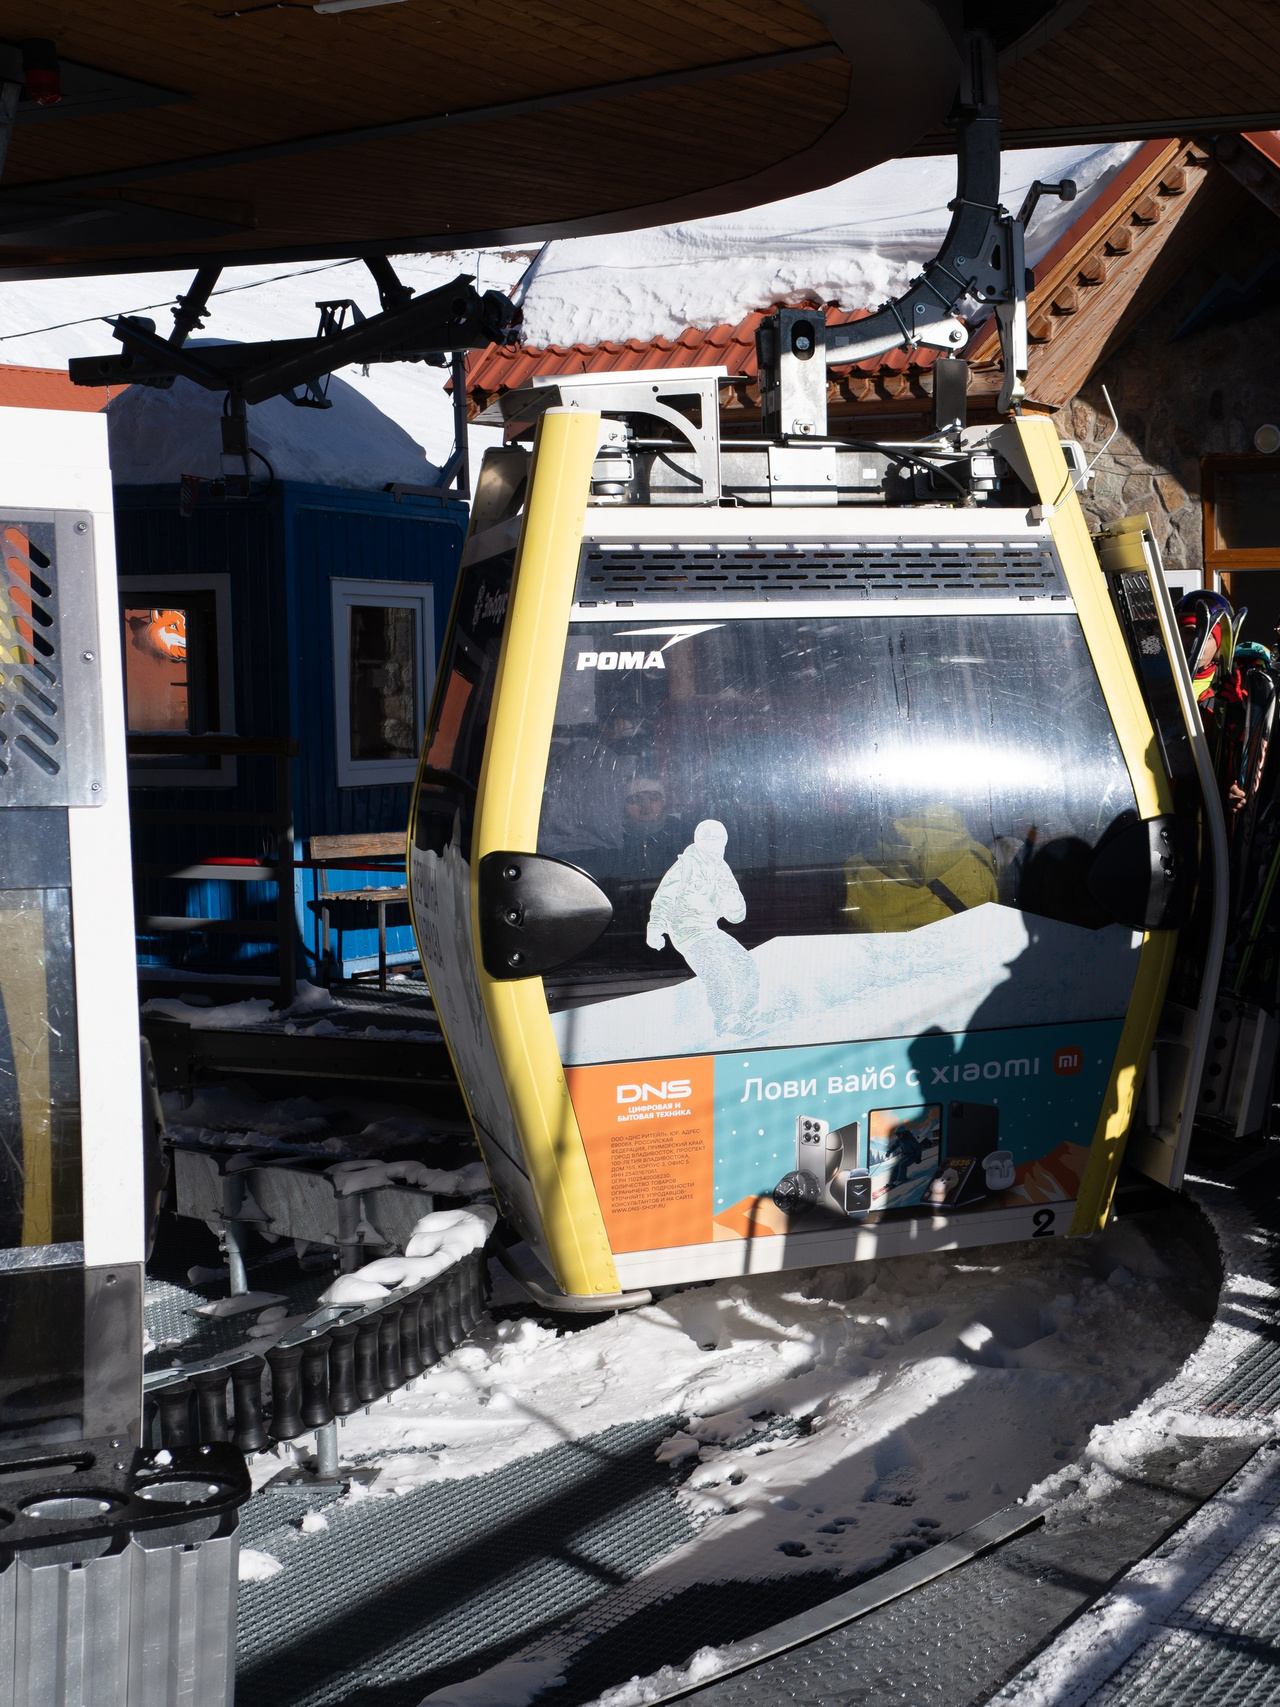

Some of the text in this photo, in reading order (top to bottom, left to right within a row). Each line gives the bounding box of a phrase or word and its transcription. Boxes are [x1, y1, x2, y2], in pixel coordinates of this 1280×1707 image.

[576, 651, 666, 671] POMA
[740, 1078, 817, 1103] Лови
[827, 1067, 896, 1095] вайб
[904, 1070, 920, 1087] с
[616, 1079, 692, 1104] DNS
[628, 1104, 673, 1114] ЦИФРОВАЯ
[617, 1109, 692, 1122] БЫТОВАЯ ТЕХНИКА
[635, 1137, 674, 1146] РОССИЙСКАЯ
[648, 1142, 688, 1150] ПРИМОРСКИЙ
[611, 1182, 650, 1190] КОЛИЧЕСТВО
[652, 1183, 695, 1192] ПОДРОБНОСТИ
[611, 1193, 645, 1202] УТОЧНЯЙТЕ
[611, 1198, 660, 1208] КОНСУЛЬТАНТОВ
[612, 1203, 666, 1214] WWW.DNS-SHOP.RU
[1031, 1208, 1056, 1239] 2
